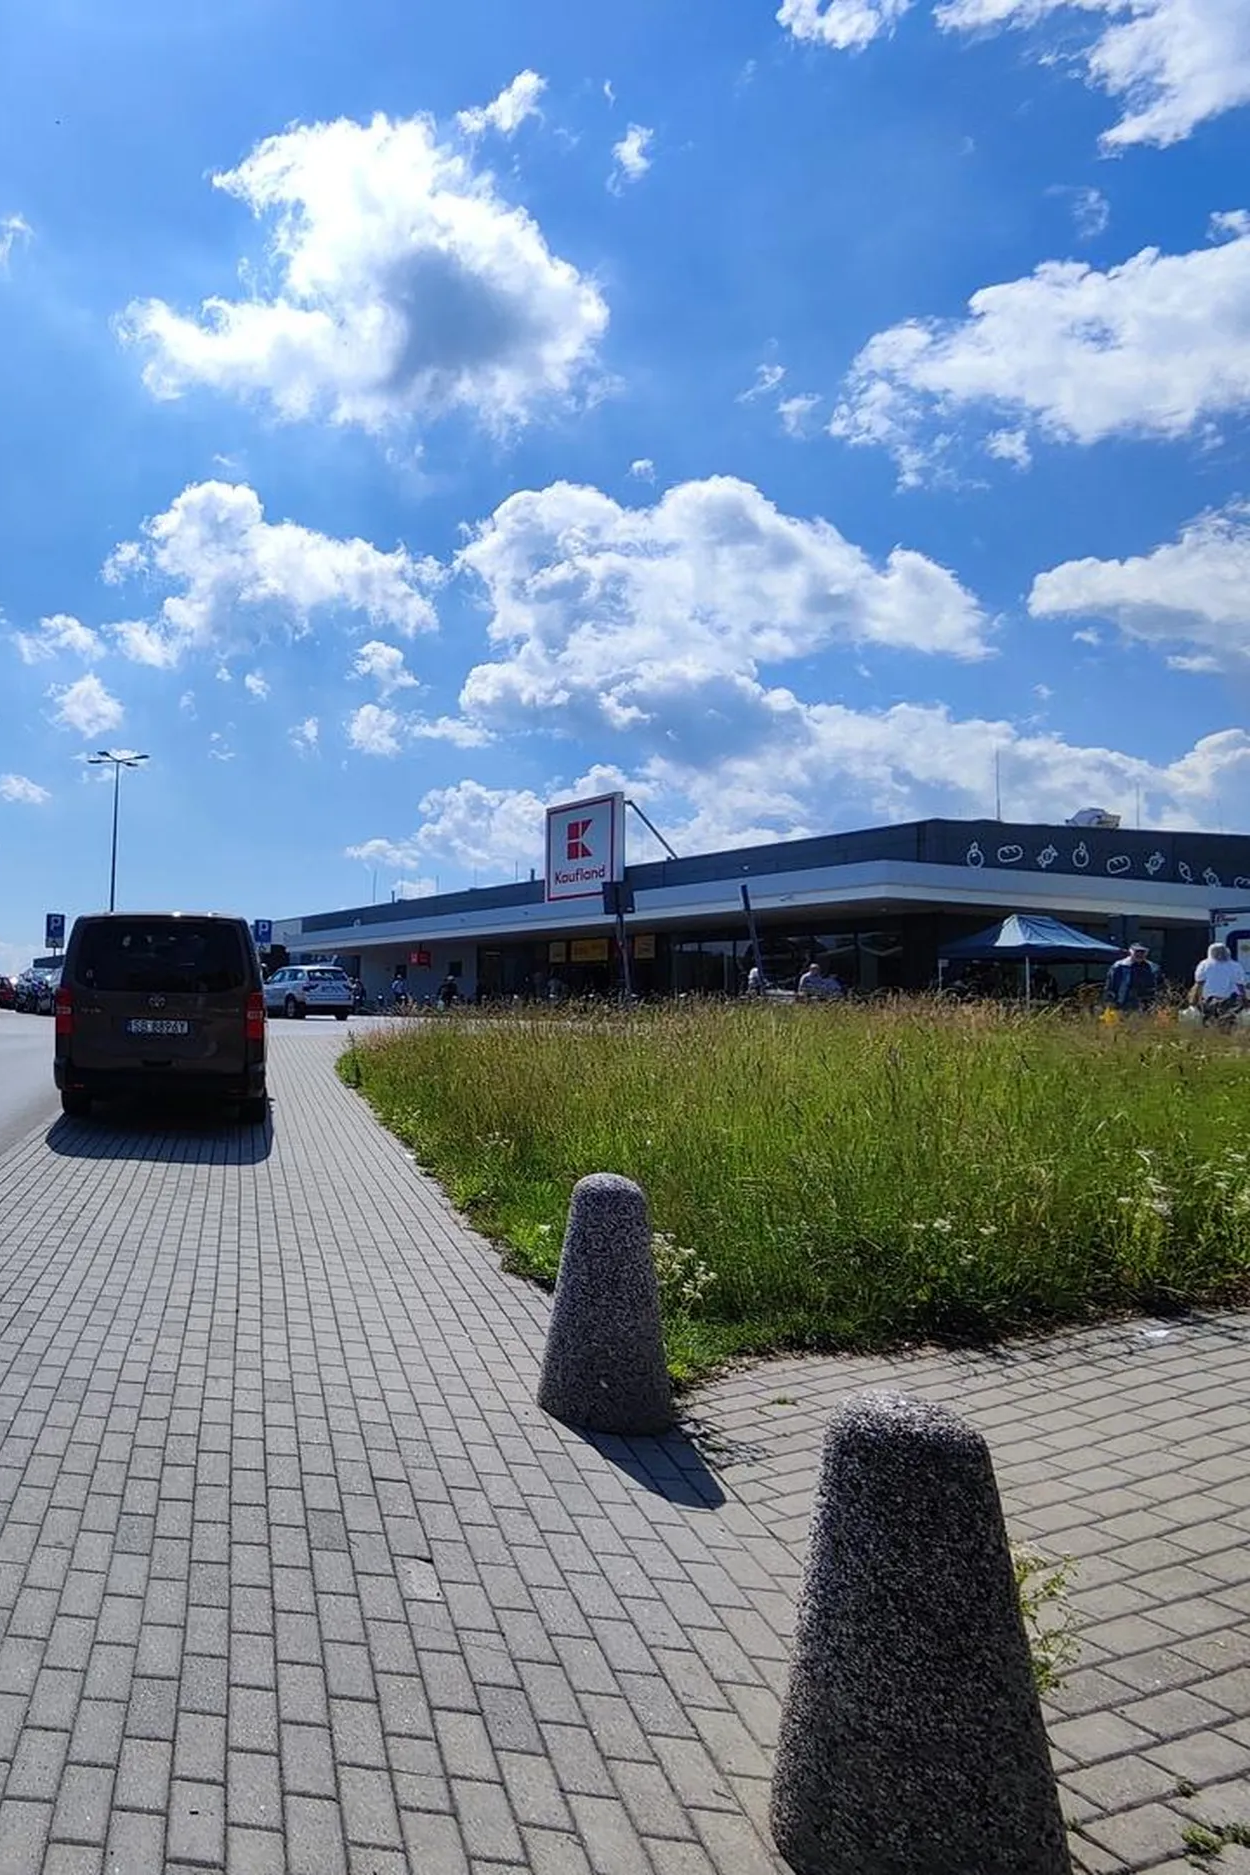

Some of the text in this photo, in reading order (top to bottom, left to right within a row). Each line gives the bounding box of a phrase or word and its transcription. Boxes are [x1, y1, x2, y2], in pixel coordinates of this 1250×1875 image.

[567, 819, 593, 860] K
[554, 865, 606, 885] Kaufland
[50, 916, 61, 931] P
[258, 921, 269, 936] P
